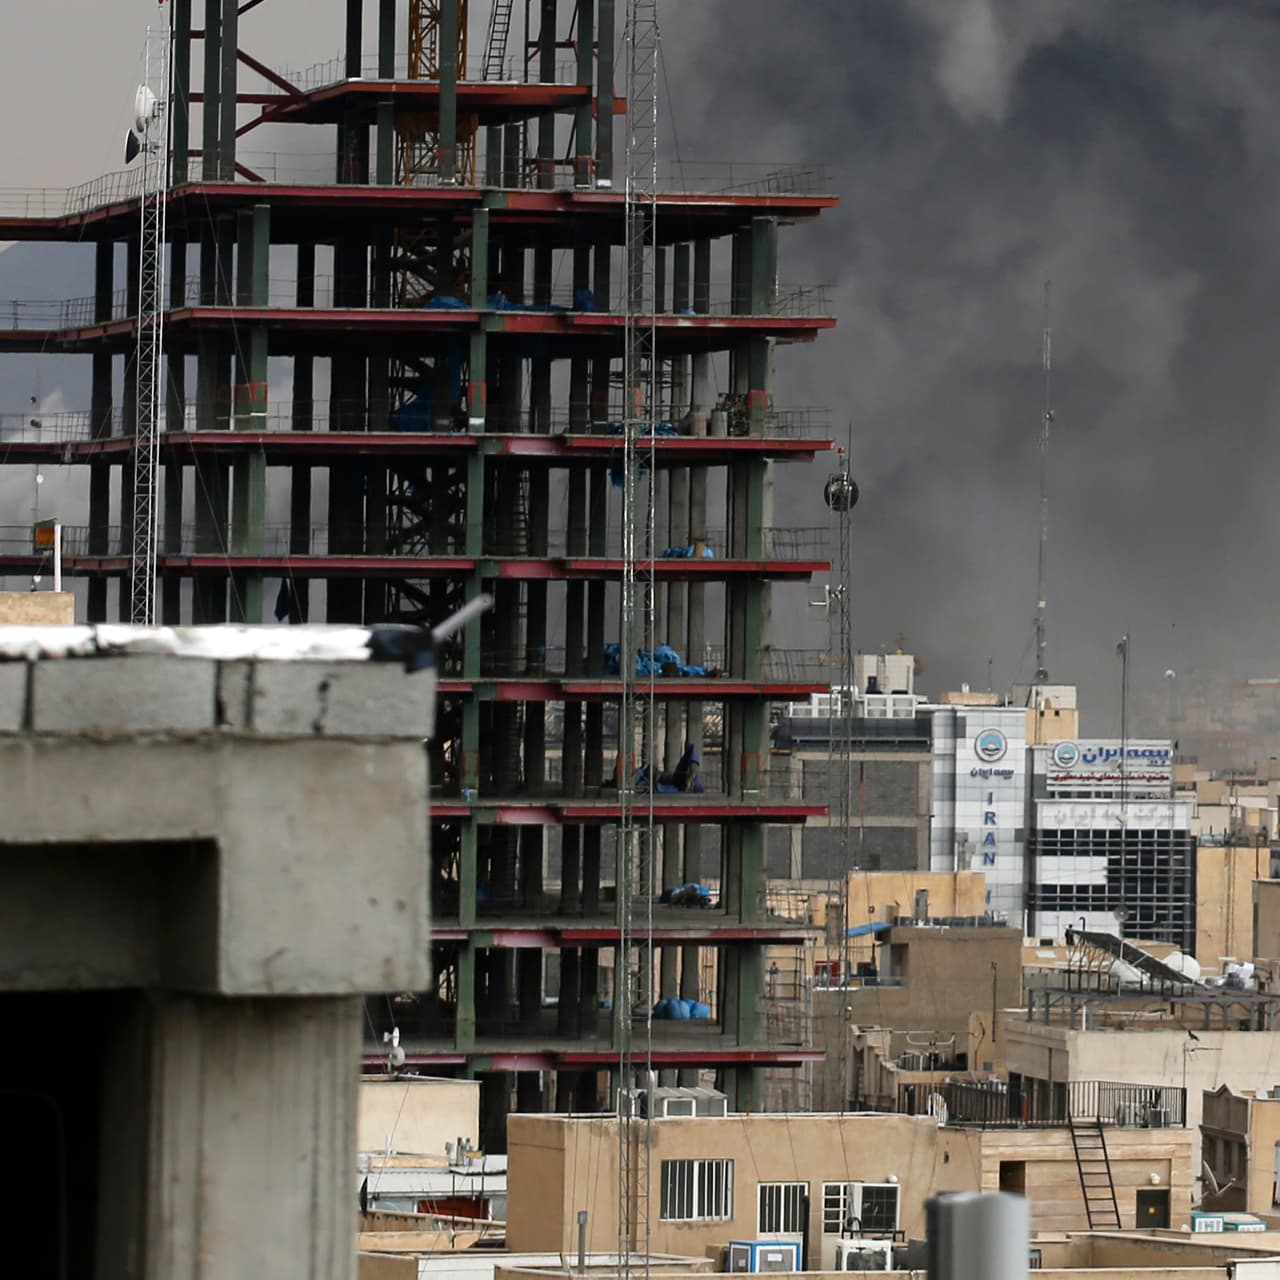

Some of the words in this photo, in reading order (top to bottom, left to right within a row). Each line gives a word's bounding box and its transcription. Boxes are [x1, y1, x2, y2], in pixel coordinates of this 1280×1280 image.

[1082, 746, 1124, 764] ایران
[1127, 748, 1169, 765] بیمه
[983, 792, 996, 866] IRAN
